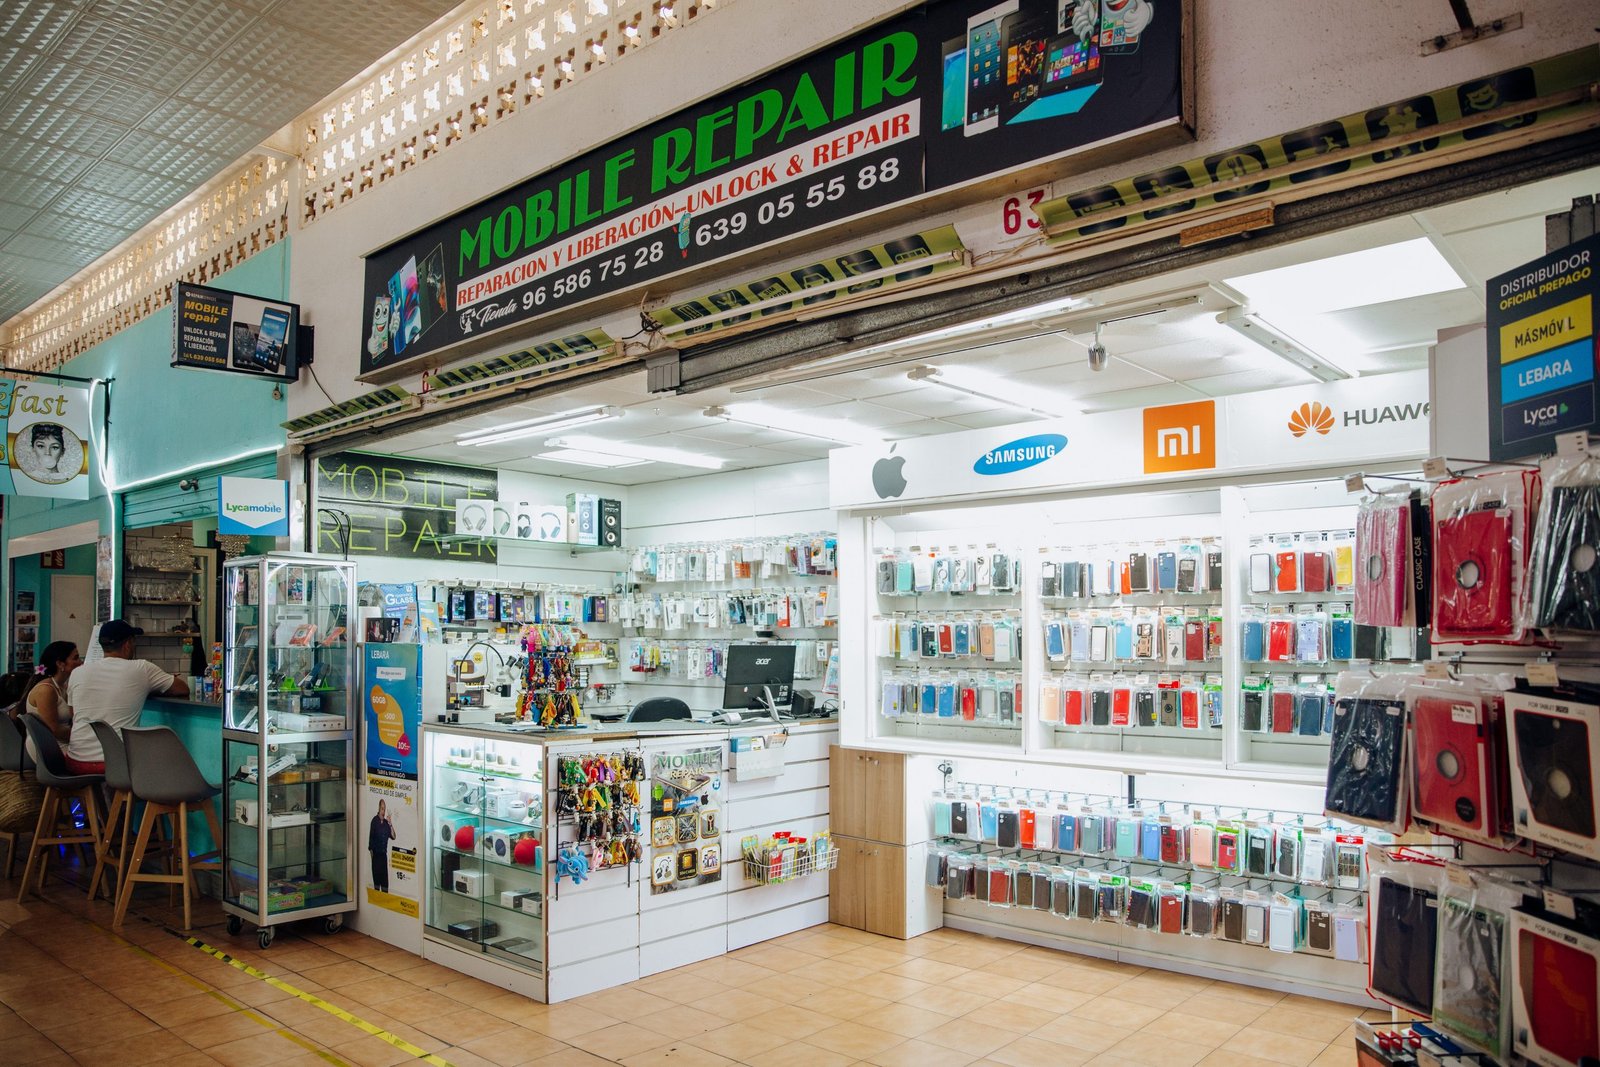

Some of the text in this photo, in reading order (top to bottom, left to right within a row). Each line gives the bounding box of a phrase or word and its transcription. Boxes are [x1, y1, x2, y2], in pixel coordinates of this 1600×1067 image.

[459, 31, 918, 277] MOBILE REPAIR
[458, 255, 548, 305] REPARACION
[552, 248, 563, 268] Y
[786, 155, 803, 177] &
[813, 113, 911, 168] REPAIR
[1003, 189, 1045, 235] 63
[475, 157, 900, 327] Tienda 96 586 75 28 639 05 55 88
[1500, 250, 1590, 297] DISTRIBUIDOR
[1500, 266, 1592, 311] OFICIAL PREPAGO
[183, 312, 219, 324] repair
[184, 301, 229, 316] MOBILE
[183, 326, 204, 336] UNLOCK
[209, 330, 227, 339] REPAIR
[1518, 359, 1573, 387] LEBARA
[1523, 402, 1558, 425] Lyca
[985, 444, 1056, 465] SAMSUNG
[318, 463, 488, 511] MOBILE
[226, 502, 282, 514] Lycamobile
[1414, 536, 1424, 591] CLASSIC CASE
[371, 650, 390, 659] LEBARA
[670, 767, 705, 779] REPAIR
